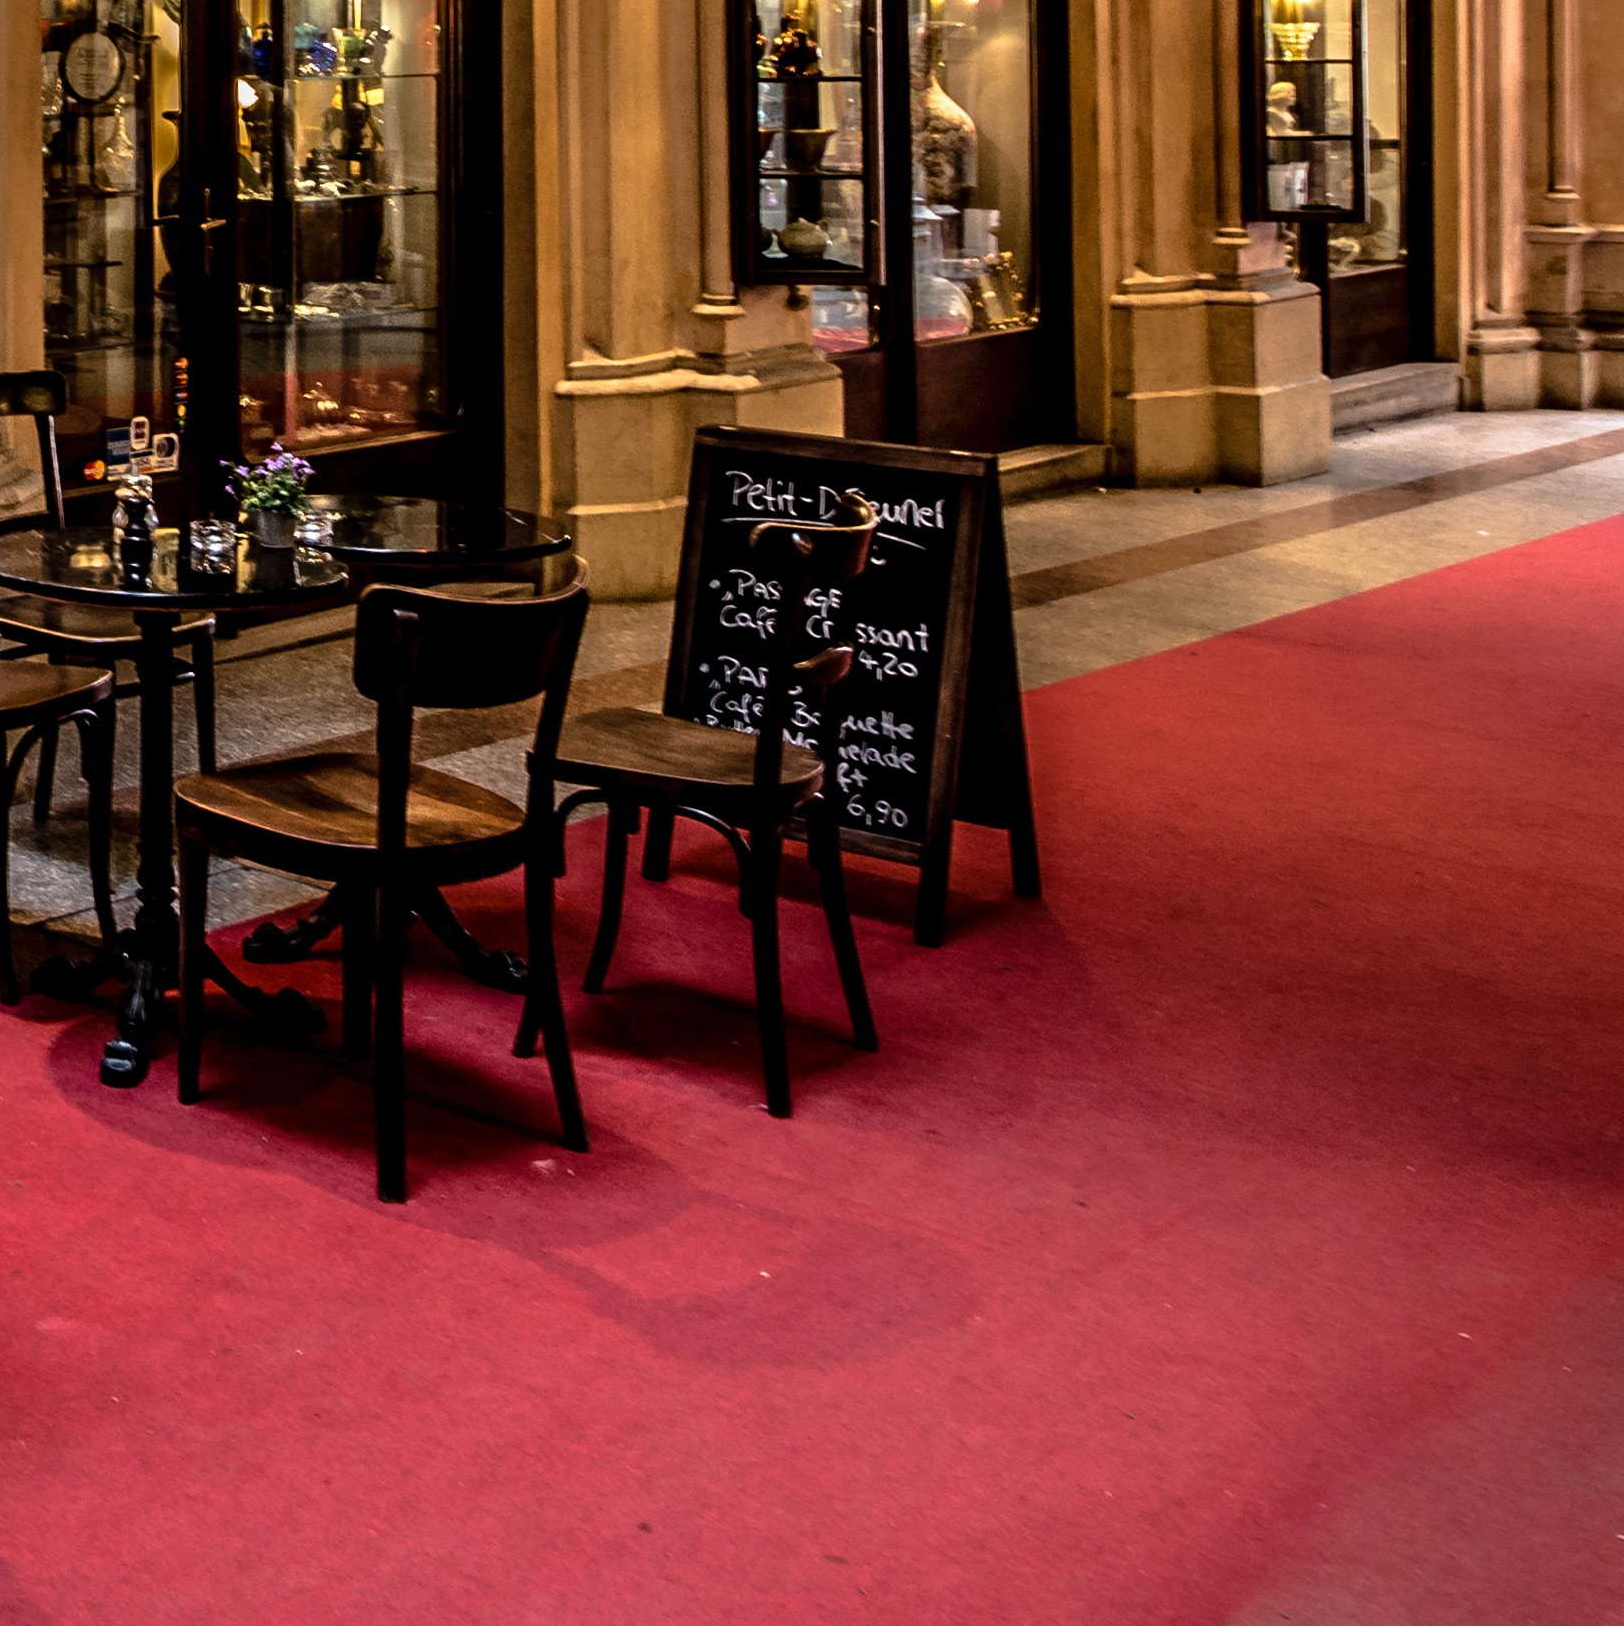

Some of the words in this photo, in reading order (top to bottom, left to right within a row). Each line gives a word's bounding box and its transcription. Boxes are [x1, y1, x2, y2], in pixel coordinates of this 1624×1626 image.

[725, 471, 945, 529] Petit-Deuner
[806, 615, 928, 652] Crssant
[859, 650, 918, 681] 4,20
[790, 702, 915, 741] Bauette
[847, 794, 909, 827] 6,90
